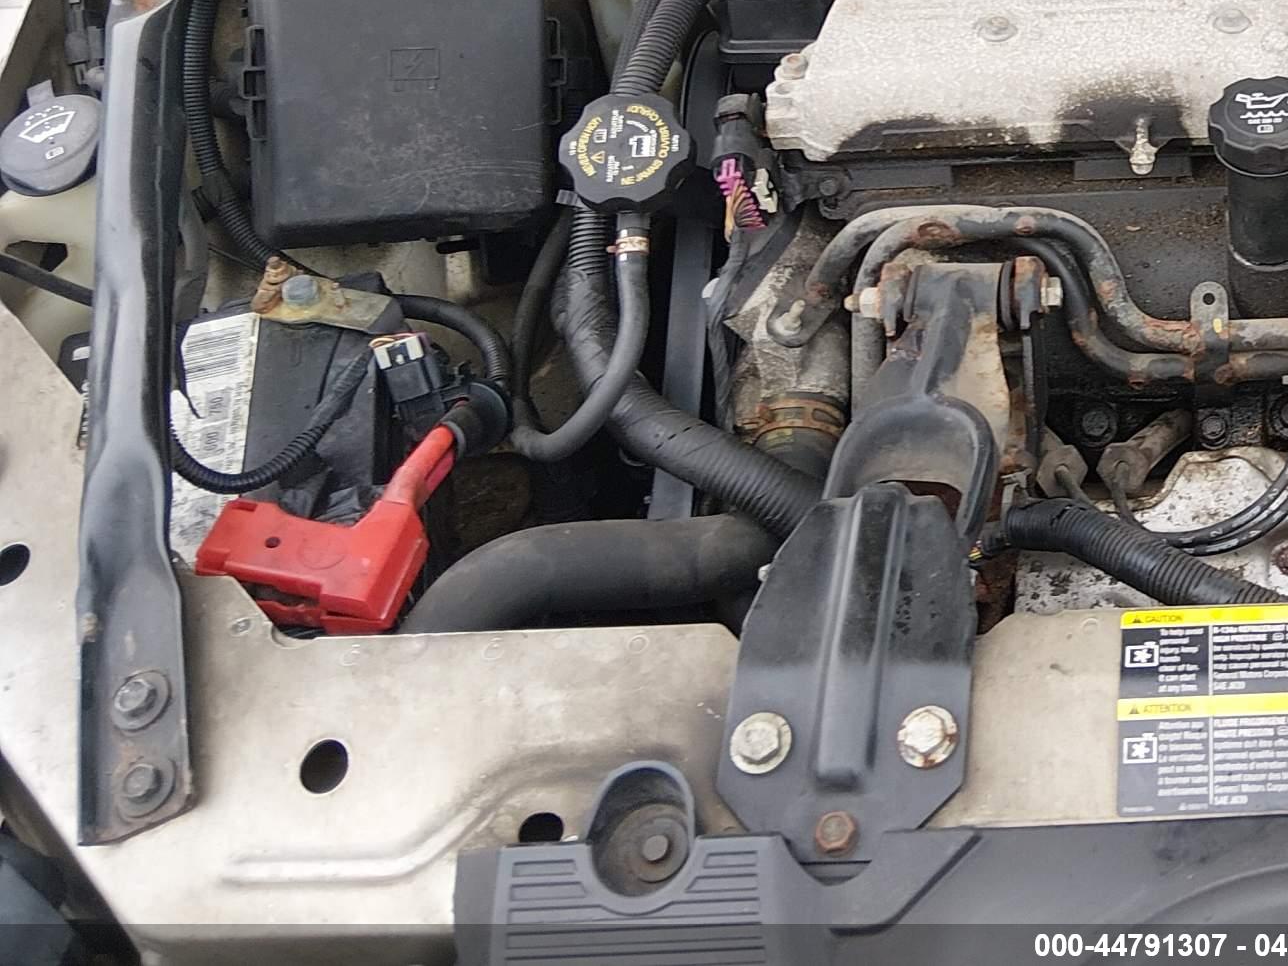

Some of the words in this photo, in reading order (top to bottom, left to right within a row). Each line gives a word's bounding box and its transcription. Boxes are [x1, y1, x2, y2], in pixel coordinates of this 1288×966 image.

[577, 132, 590, 152] OPEN
[1145, 615, 1183, 623] CAUTION
[1143, 704, 1192, 714] ATTENTION
